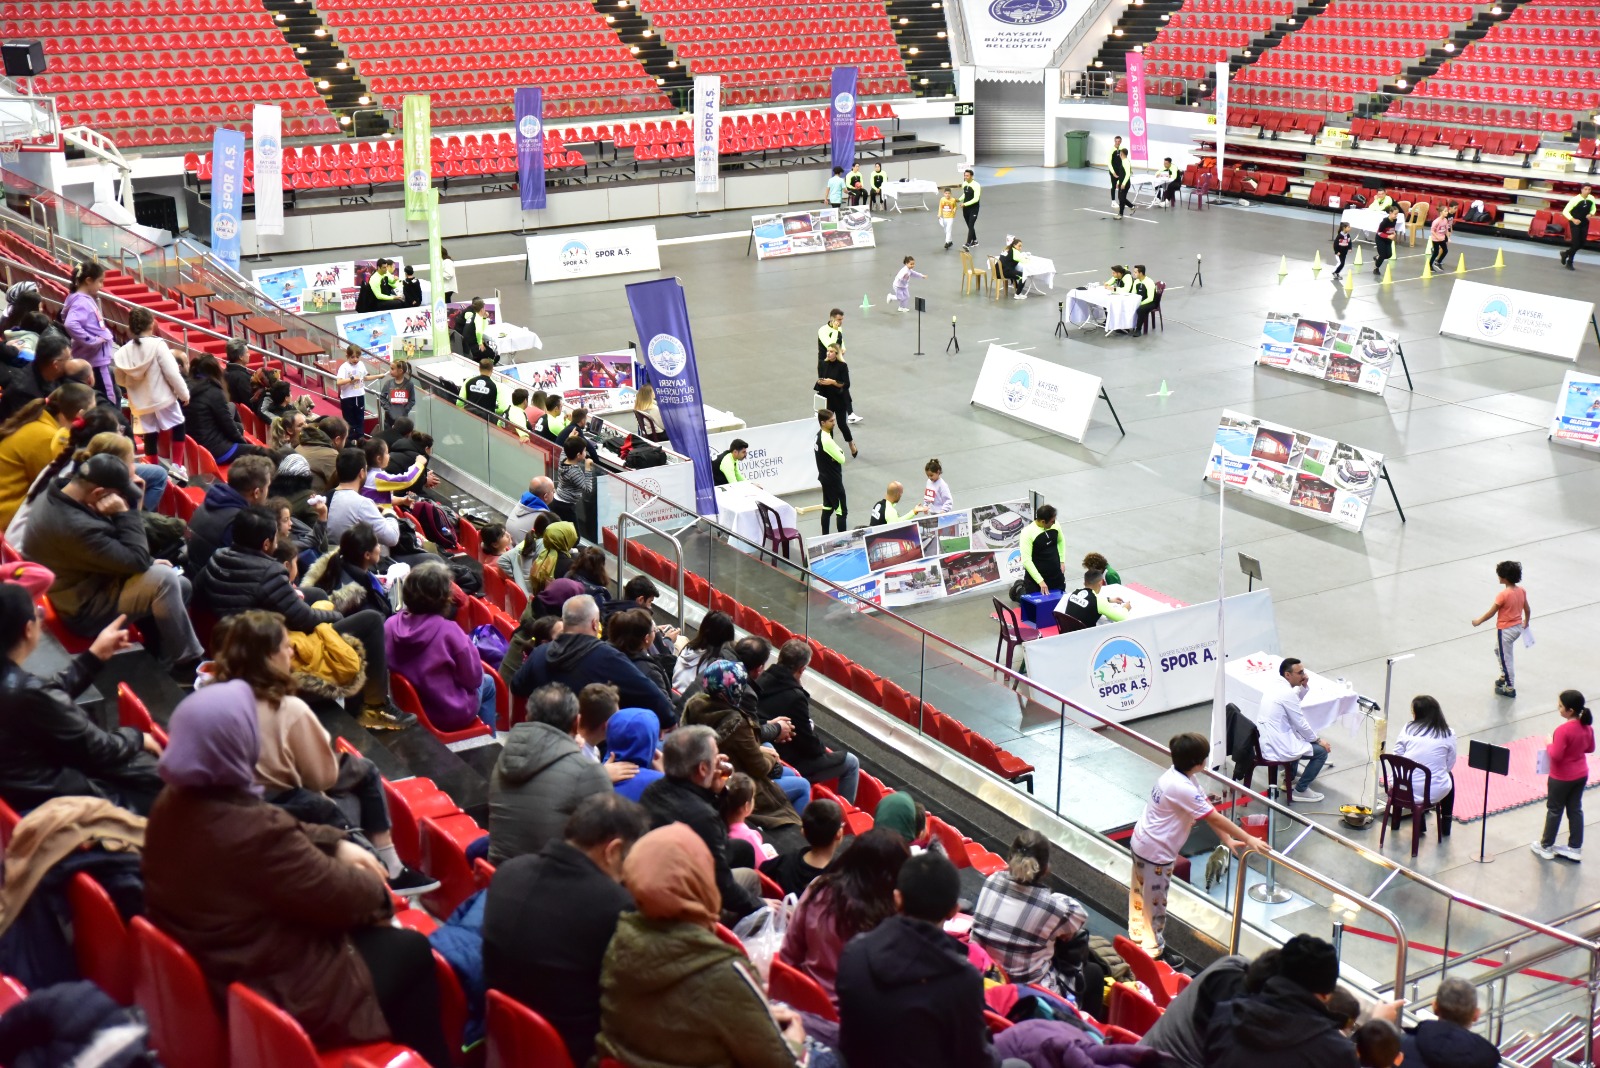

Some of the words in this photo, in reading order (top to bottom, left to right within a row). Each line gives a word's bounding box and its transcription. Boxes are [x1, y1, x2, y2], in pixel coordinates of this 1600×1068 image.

[705, 113, 714, 141] SPOR
[223, 175, 235, 209] SPOR
[595, 249, 615, 258] SPOR
[617, 247, 632, 256] A.Ş.
[1517, 308, 1544, 320] KAYSERİ
[1037, 380, 1059, 393] KAYSERİ
[738, 456, 784, 471] ÜYÜKŞEHİR
[1161, 651, 1199, 673] SPOR
[1099, 682, 1127, 698] SPOR
[1130, 677, 1150, 691] A.Ş.
